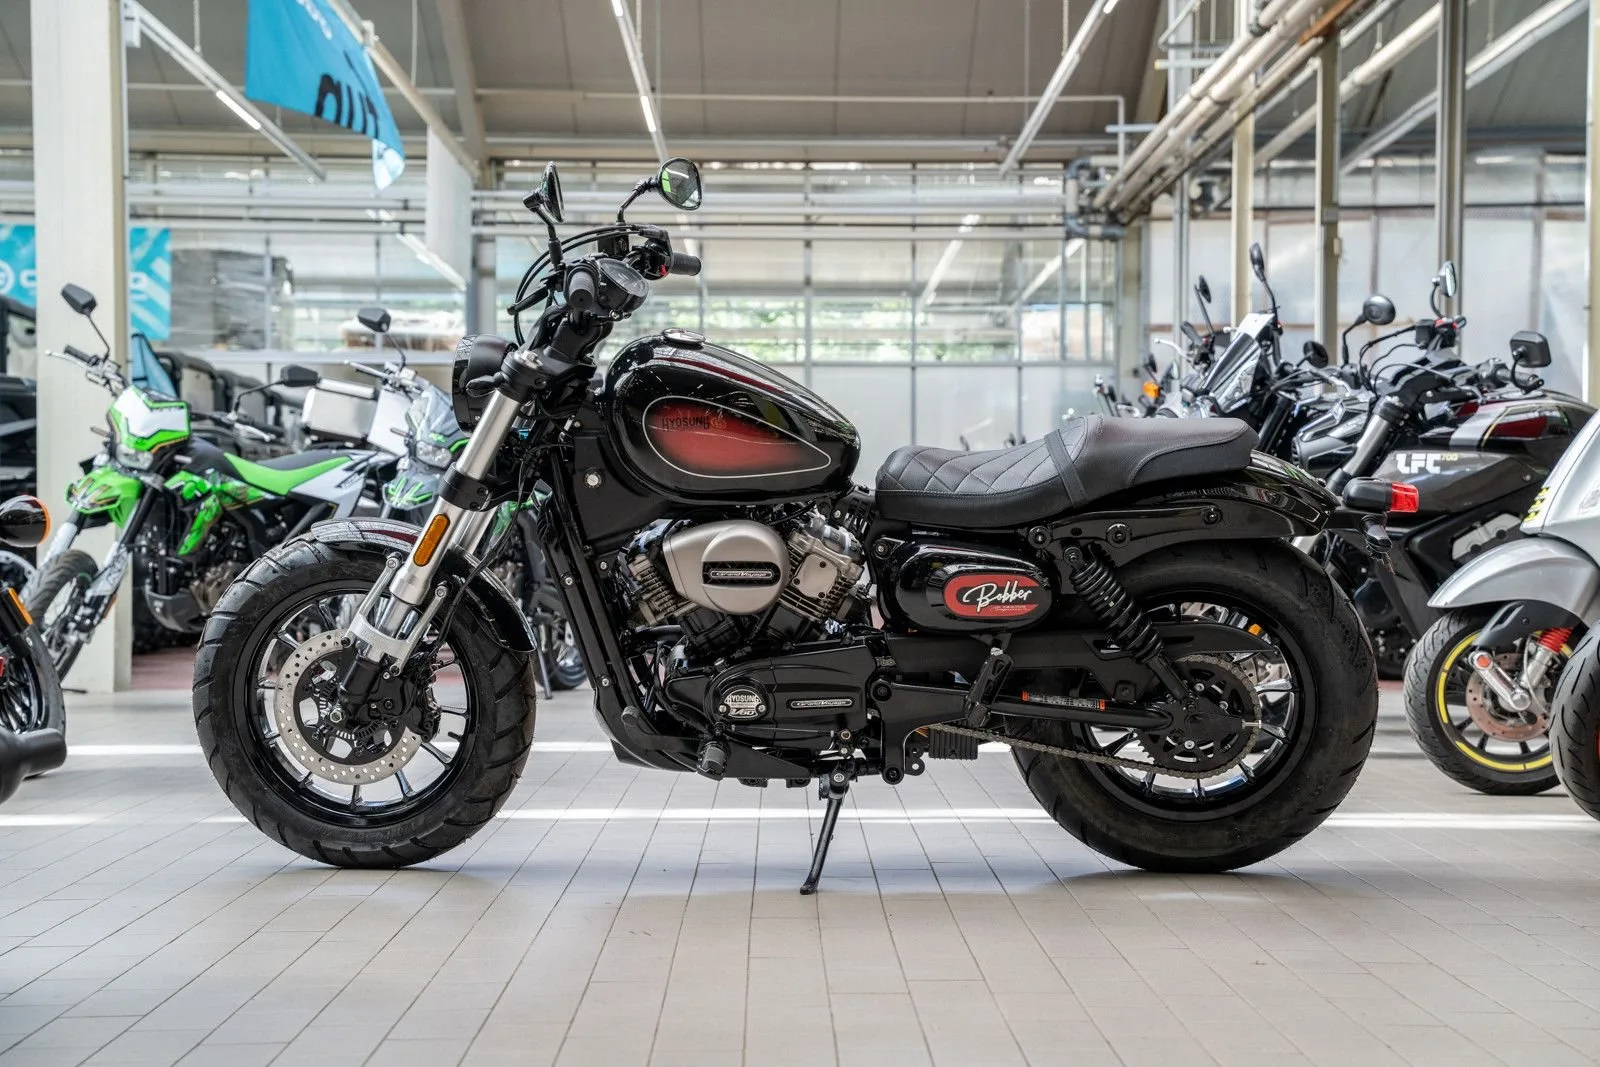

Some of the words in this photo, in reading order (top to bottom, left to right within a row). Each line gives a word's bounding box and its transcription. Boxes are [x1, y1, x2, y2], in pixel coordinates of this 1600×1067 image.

[661, 415, 710, 432] HYOSUNG
[962, 580, 1032, 613] Bobber
[727, 694, 760, 704] HYOSUNG
